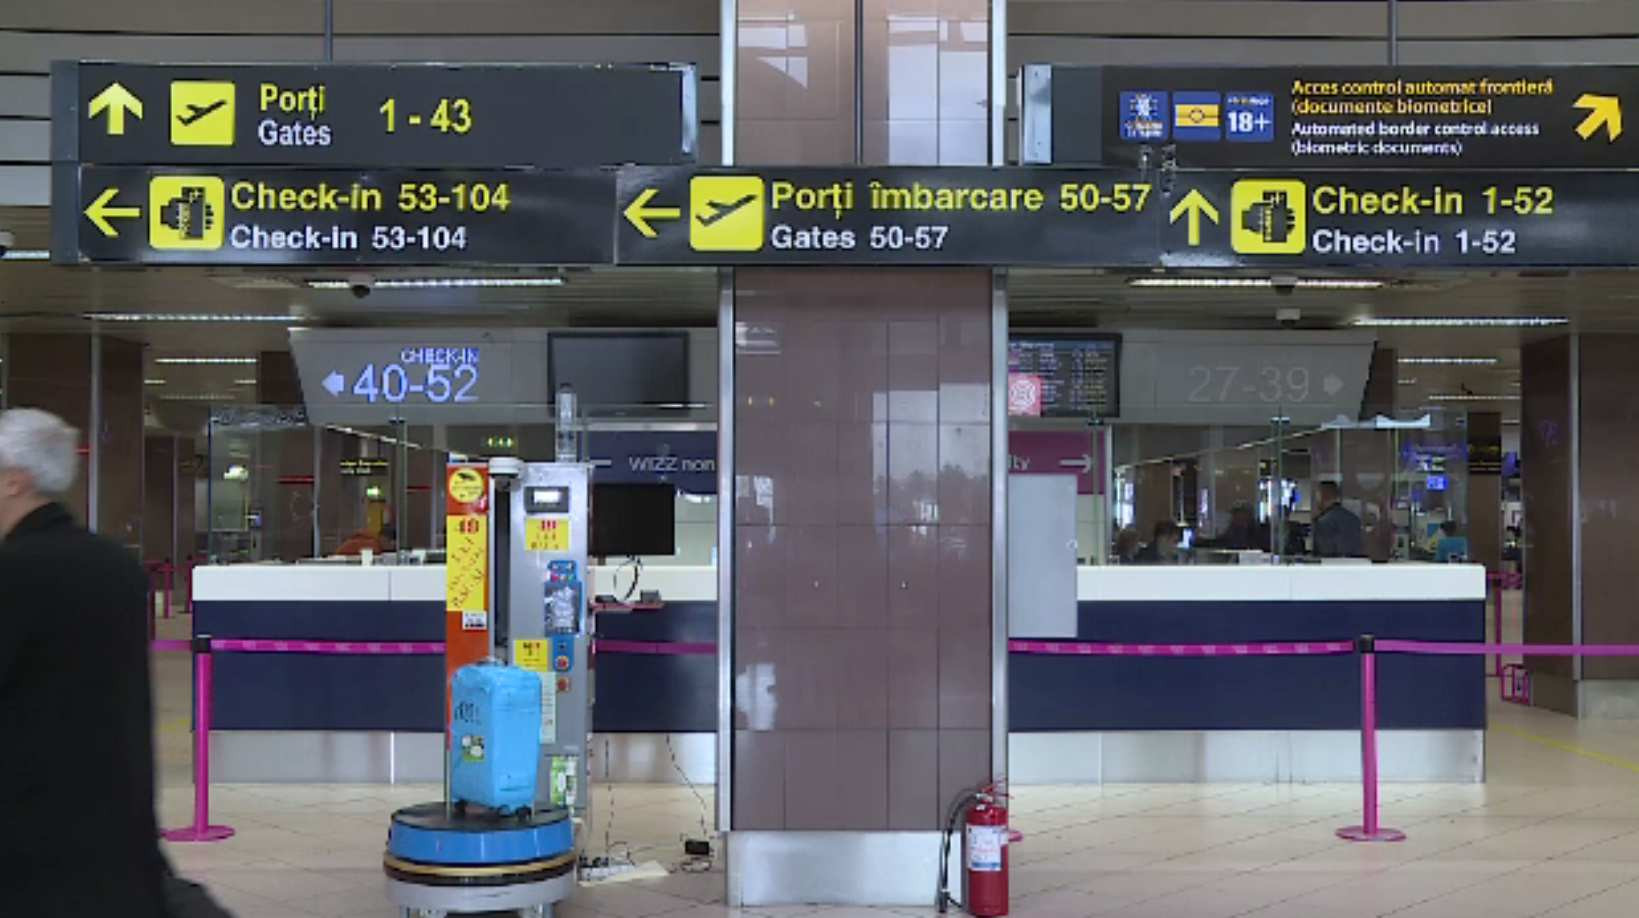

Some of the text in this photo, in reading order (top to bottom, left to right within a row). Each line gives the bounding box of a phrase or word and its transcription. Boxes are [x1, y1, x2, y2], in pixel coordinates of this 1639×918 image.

[1291, 80, 1339, 95] Acces
[1342, 79, 1401, 95] control
[1405, 80, 1477, 95] automat
[430, 98, 472, 132] 43
[1291, 98, 1394, 116] (documente
[257, 119, 331, 146] Gates
[1227, 111, 1273, 133] 18+
[1291, 120, 1540, 136] Automated border control access
[1291, 139, 1463, 157] (biometric documents)
[231, 182, 511, 211] Check-in 53-104
[869, 181, 1044, 212] îmbarcare
[1060, 183, 1152, 212] 50-57
[1312, 186, 1554, 216] Check-in 1-52
[230, 224, 466, 251] Check-in 53-104
[771, 224, 949, 250] Gates 50-57
[1312, 229, 1517, 255] Check-in 1-52
[401, 347, 479, 364] CHECK-IN
[353, 363, 479, 402] 40-52
[1187, 366, 1309, 402] 27-39
[628, 456, 715, 471] WIZZ non
